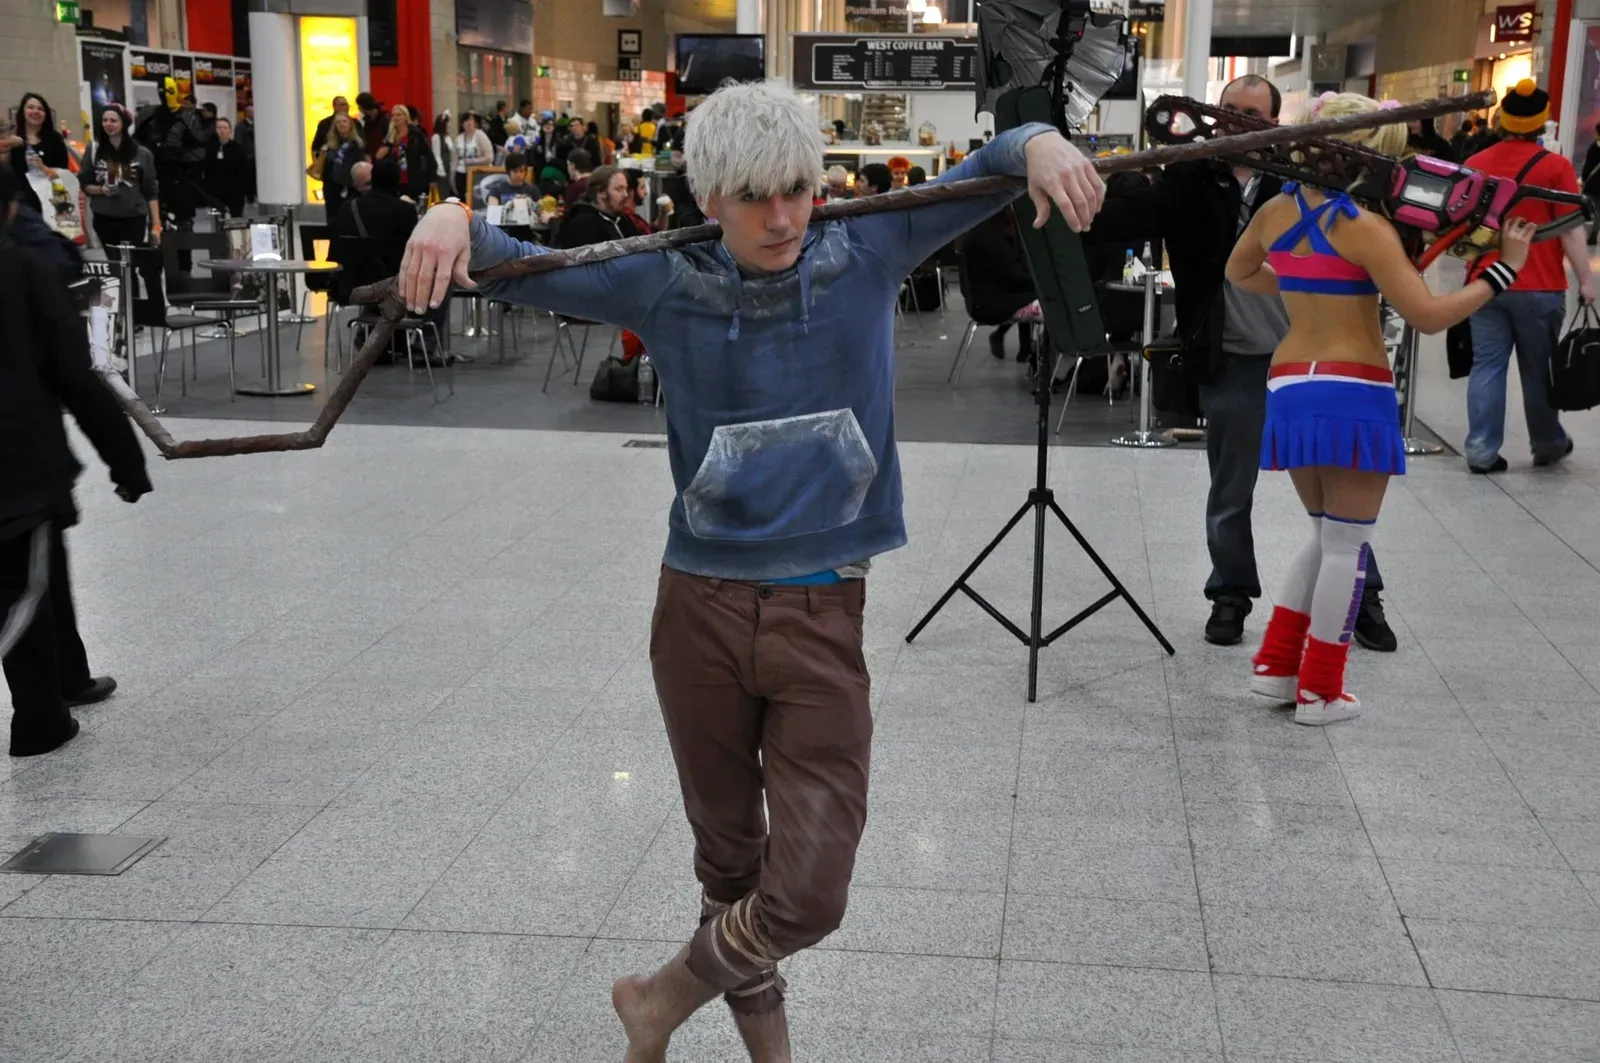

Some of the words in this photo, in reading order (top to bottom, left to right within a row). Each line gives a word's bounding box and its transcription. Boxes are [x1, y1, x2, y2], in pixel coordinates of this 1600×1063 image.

[1499, 12, 1533, 29] WS
[867, 41, 892, 50] WEST
[893, 41, 924, 51] COFFEE
[926, 41, 944, 51] BAR
[82, 262, 111, 275] ATTE
